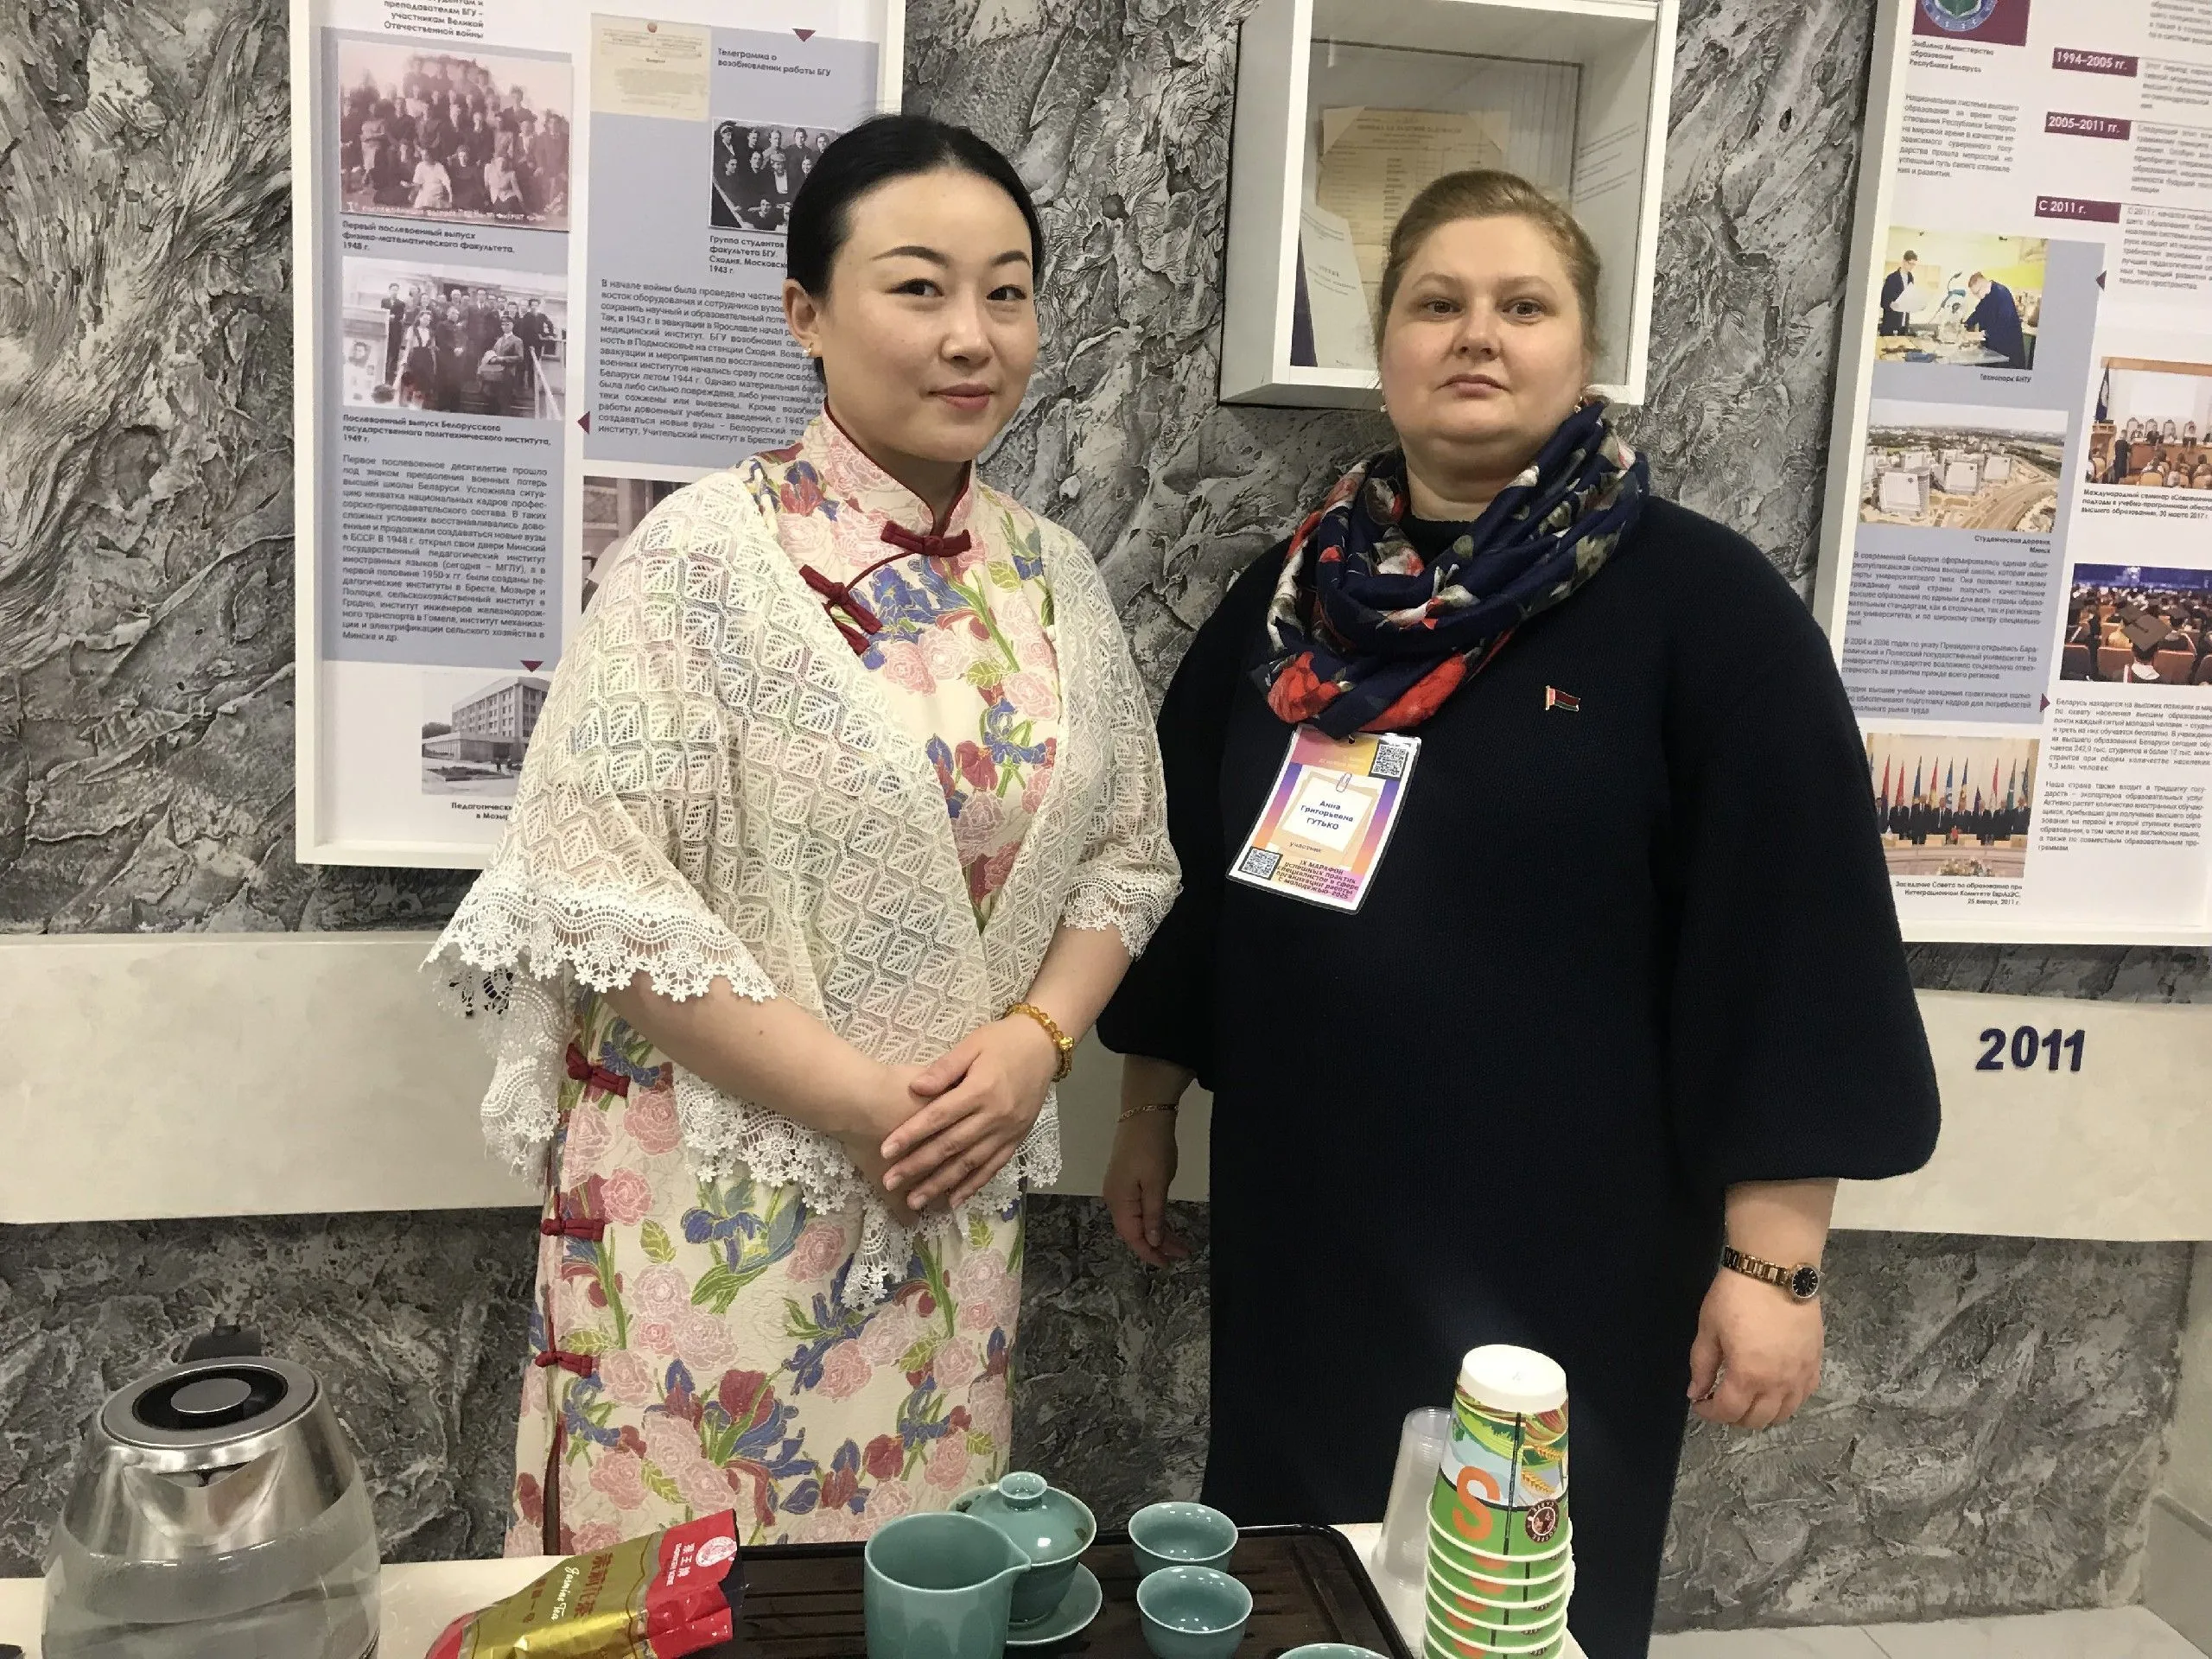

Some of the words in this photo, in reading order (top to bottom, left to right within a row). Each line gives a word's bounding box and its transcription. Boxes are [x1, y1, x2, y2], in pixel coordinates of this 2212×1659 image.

[385, 1, 460, 14] преподавателям
[461, 7, 476, 16] БГУ
[391, 12, 444, 23] участникам
[447, 16, 484, 28] Великой
[384, 21, 454, 35] Отечественной
[455, 29, 484, 38] войны
[718, 48, 769, 60] Телеграмма
[718, 60, 781, 71] возобновлении
[783, 65, 815, 74] работы
[817, 67, 831, 75] БГУ
[2038, 200, 2048, 211] С
[2050, 201, 2075, 213] 2011
[342, 221, 376, 232] Первый
[378, 226, 442, 236] послевоенный
[444, 230, 475, 239] выпуск
[343, 240, 362, 249] 1948
[709, 235, 739, 245] Группа
[741, 239, 785, 248] студентов
[709, 245, 760, 256] факультета
[709, 264, 728, 273] 1943
[600, 359, 638, 368] военных
[639, 363, 688, 372] институтов
[690, 366, 731, 375] начались
[733, 369, 757, 378] сразу
[600, 368, 639, 380] Беларуси
[673, 374, 693, 383] 1944
[704, 377, 736, 386] Однако
[738, 380, 800, 391] материальная
[599, 403, 631, 411] работы
[634, 406, 683, 416] довоенных
[686, 410, 722, 418] учебных
[785, 415, 804, 424] 1945
[643, 427, 697, 438] Учительский
[699, 433, 737, 442] институт
[747, 434, 776, 444] Бресте
[343, 455, 376, 466] Первое
[381, 459, 444, 468] послевоенное
[451, 463, 506, 473] десятилетие
[512, 467, 547, 475] прошло
[2083, 489, 2139, 498] Международный
[378, 534, 384, 543] В
[387, 535, 407, 543] 1948
[418, 538, 451, 548] открыл
[477, 542, 504, 550] двери
[506, 542, 546, 551] Минский
[451, 801, 512, 811] Педагогически
[1320, 800, 1341, 810] Анна
[482, 811, 508, 821] Мозыр
[1301, 805, 1353, 822] Григорьевна
[1306, 817, 1339, 830] ГУТЬКО
[1284, 862, 1324, 874] успешных
[1308, 862, 1344, 874] МАРАФОН
[1276, 871, 1324, 887] организации
[1325, 884, 1353, 895] работы
[1278, 866, 1328, 883] специалистов
[1336, 881, 1359, 891] сфере
[1976, 1026, 2086, 1071] 2011
[1452, 1465, 1500, 1541] S
[556, 1566, 580, 1602] Jasmine
[551, 1602, 567, 1621] Tea
